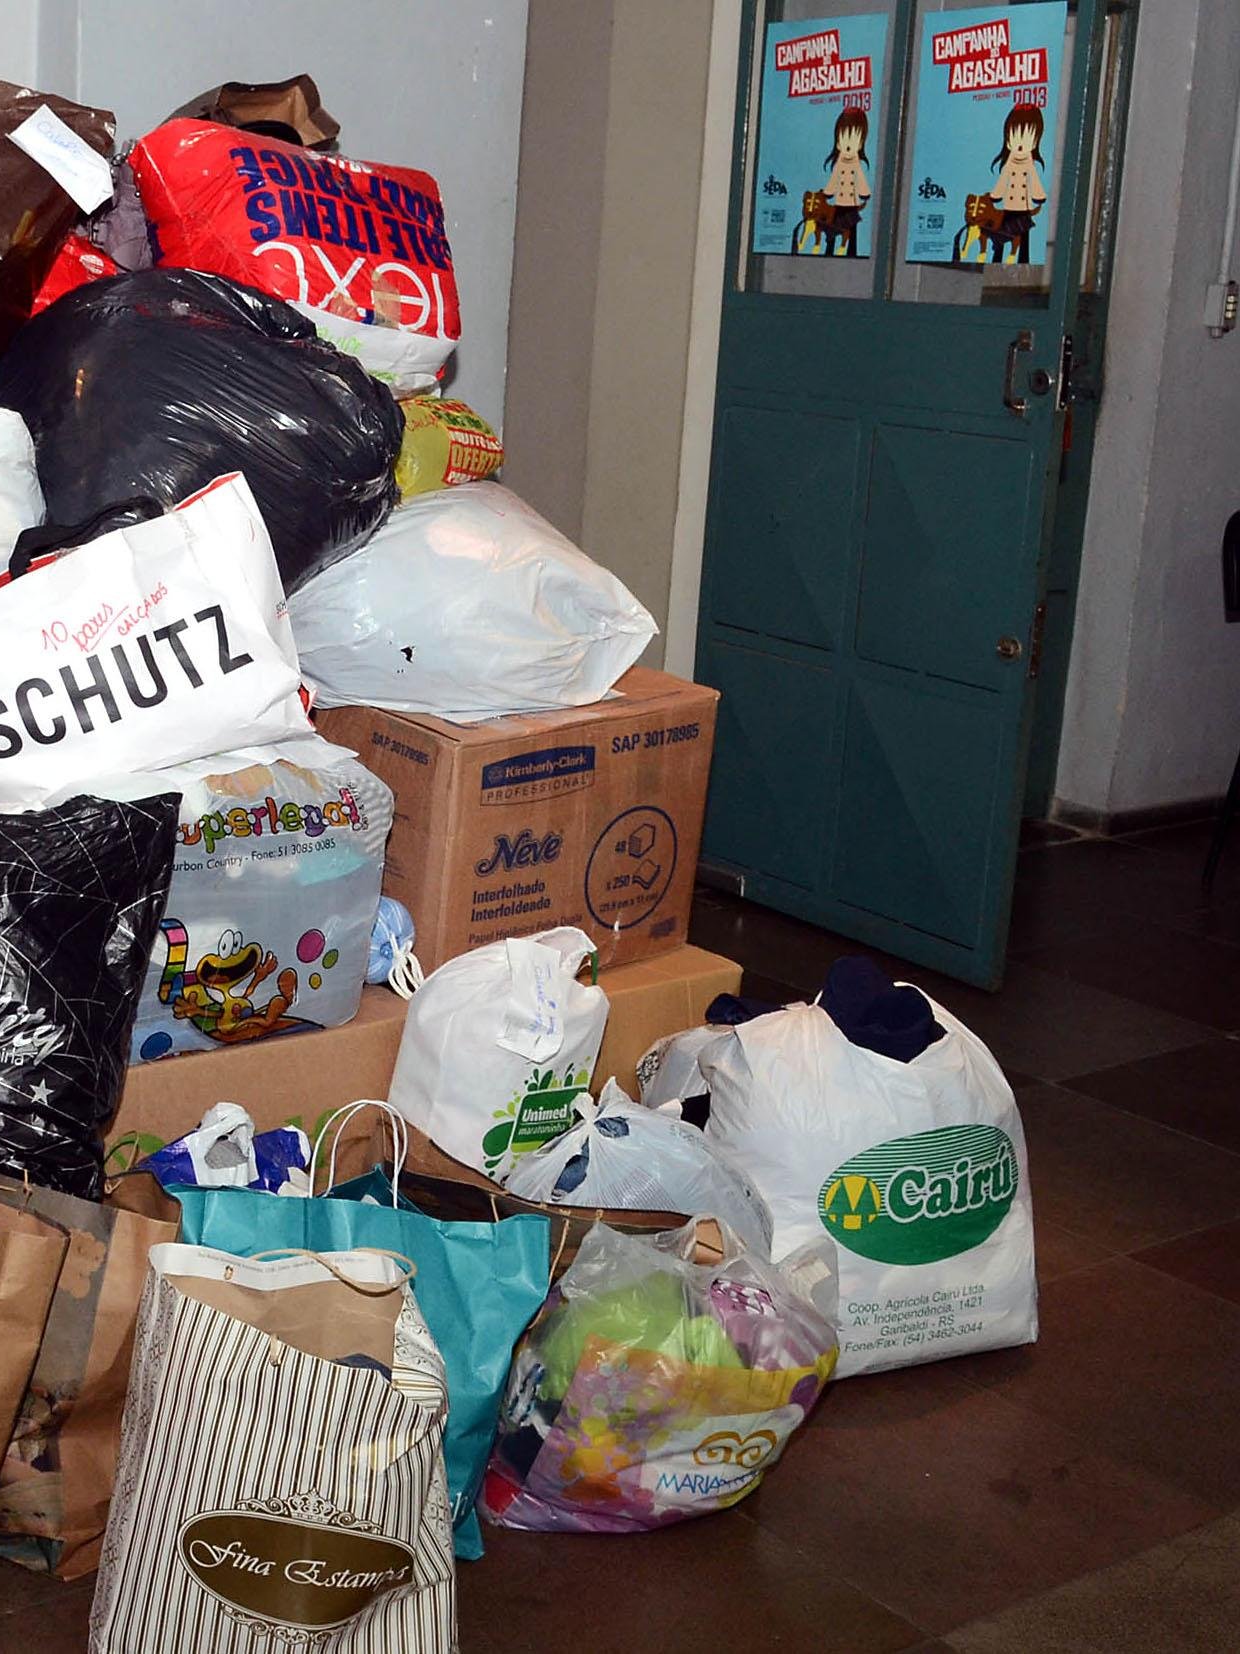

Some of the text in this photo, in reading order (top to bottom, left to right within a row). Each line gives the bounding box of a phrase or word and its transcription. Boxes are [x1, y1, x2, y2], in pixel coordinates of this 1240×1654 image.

[777, 34, 839, 67] CAMPANHA
[934, 24, 1008, 60] CAMPANHA
[791, 60, 866, 94] AGASALHO
[951, 53, 1040, 90] AGASALHO
[246, 189, 381, 255] ITEMS
[41, 620, 68, 652] 10
[611, 733, 640, 754] SAP
[505, 754, 587, 779] Kimberly-Clark
[486, 778, 589, 802] PROFESSIONAL
[176, 788, 361, 853] uperlegal
[206, 854, 243, 870] Country
[278, 846, 288, 856] 51
[291, 842, 313, 855] 3085
[474, 828, 562, 877] Neve
[472, 880, 546, 904] Interfolhado
[471, 897, 552, 922] Interfoldeado
[522, 1103, 568, 1122] Unimed
[887, 1143, 1013, 1224] Cairú
[848, 1301, 881, 1316] Coop.
[852, 1315, 870, 1327] Av.
[959, 1297, 983, 1311] 1421
[880, 1320, 929, 1337] Garibaldi
[938, 1315, 955, 1328] RS
[902, 1332, 925, 1346] (54)
[190, 1539, 277, 1577] Fina
